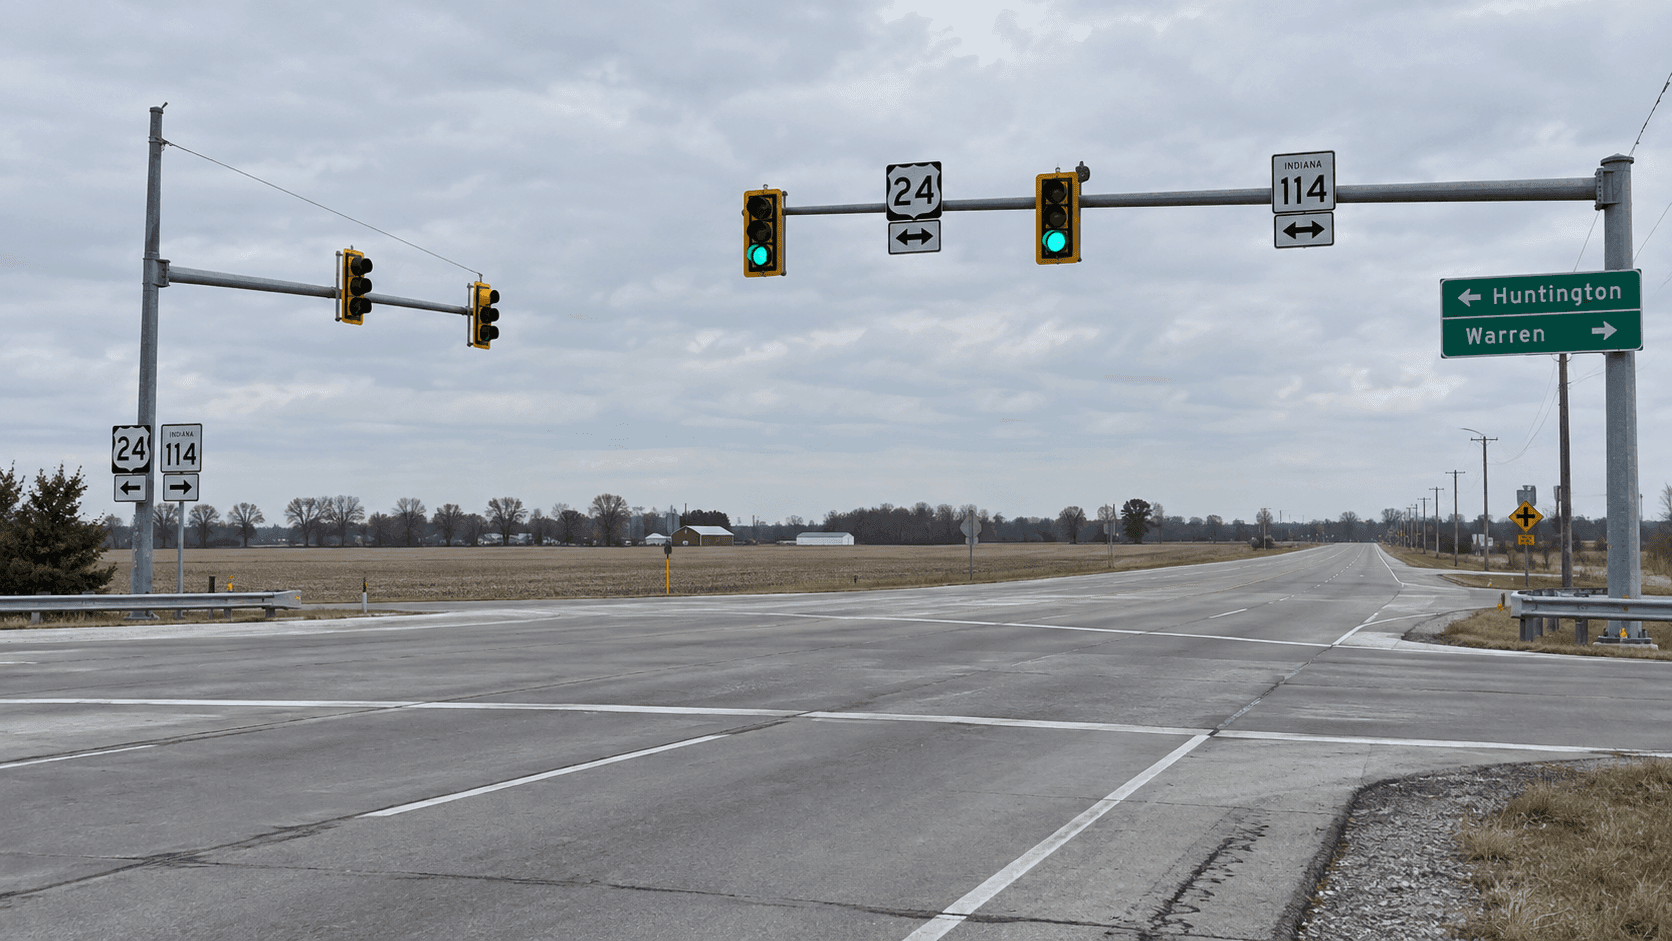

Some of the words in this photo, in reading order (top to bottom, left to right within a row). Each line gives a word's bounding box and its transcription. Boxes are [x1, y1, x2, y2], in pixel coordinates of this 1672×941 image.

[1284, 161, 1322, 170] INDIANA
[893, 175, 934, 206] 24
[1281, 174, 1327, 205] 114
[1493, 283, 1621, 306] Huntington
[1466, 327, 1545, 345] Warren
[117, 436, 145, 461] 24
[166, 443, 196, 466] 114
